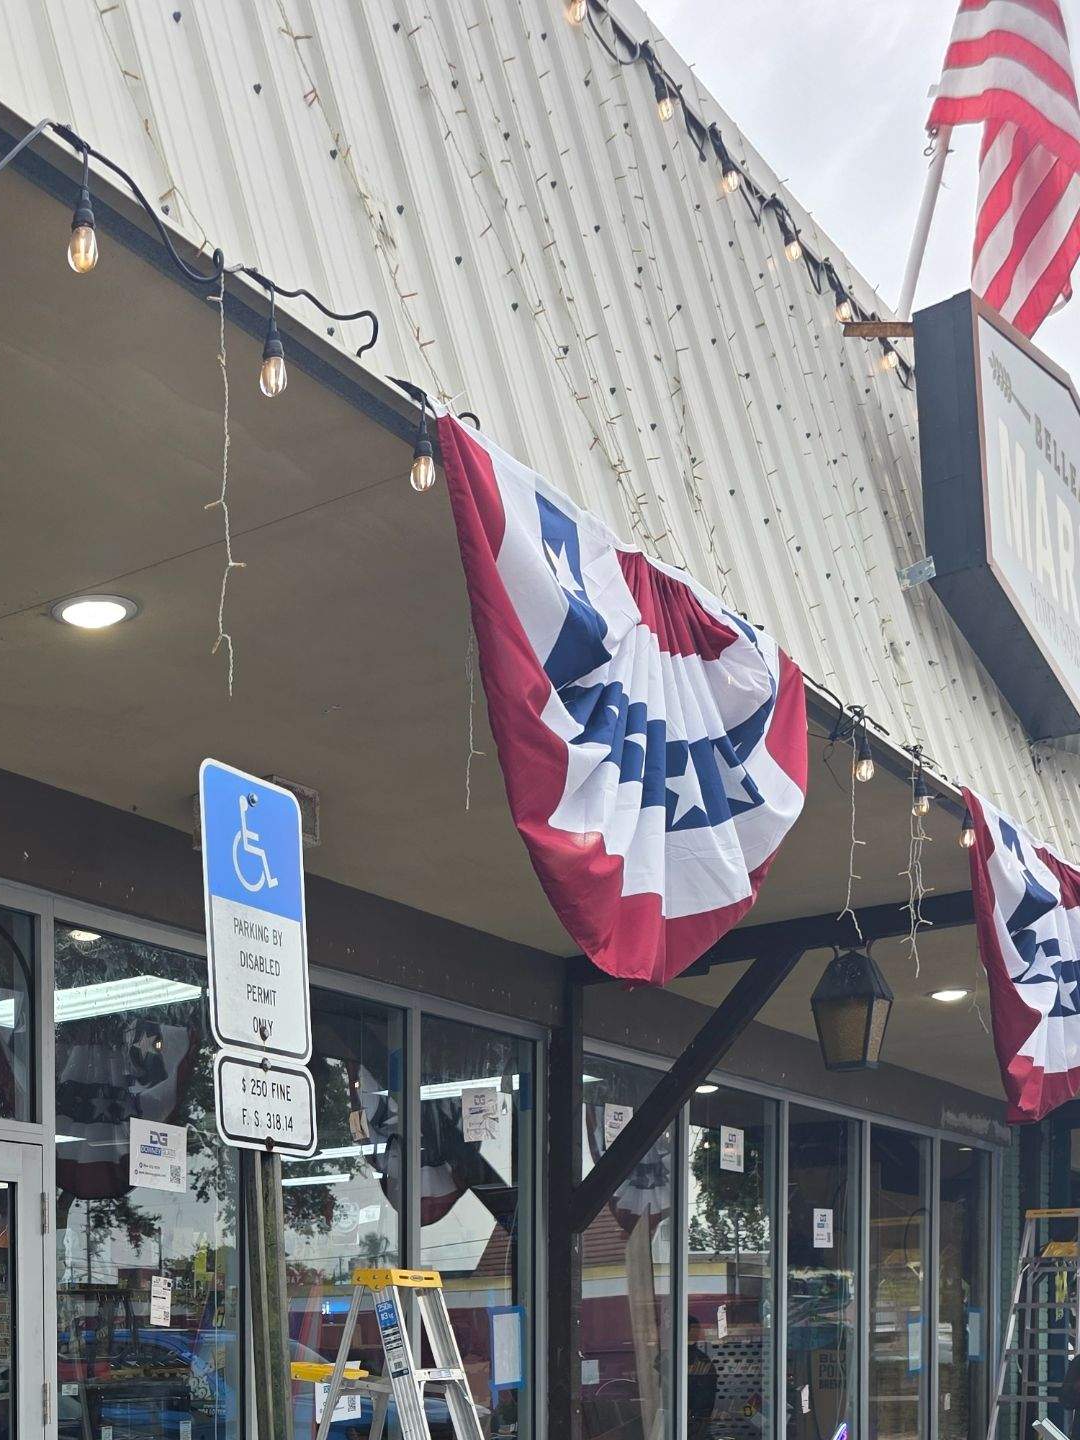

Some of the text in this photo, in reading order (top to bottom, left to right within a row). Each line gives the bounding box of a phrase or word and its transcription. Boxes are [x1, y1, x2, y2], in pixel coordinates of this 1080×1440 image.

[1034, 412, 1080, 506] BELLE
[997, 416, 1080, 630] MAR
[233, 917, 283, 947] PARKING BY
[239, 950, 281, 977] DISABLED
[246, 983, 277, 1007] PERMIT
[241, 1077, 292, 1102] $ 250 FINE
[242, 1108, 250, 1126] F.
[266, 1112, 294, 1132] 318.14
